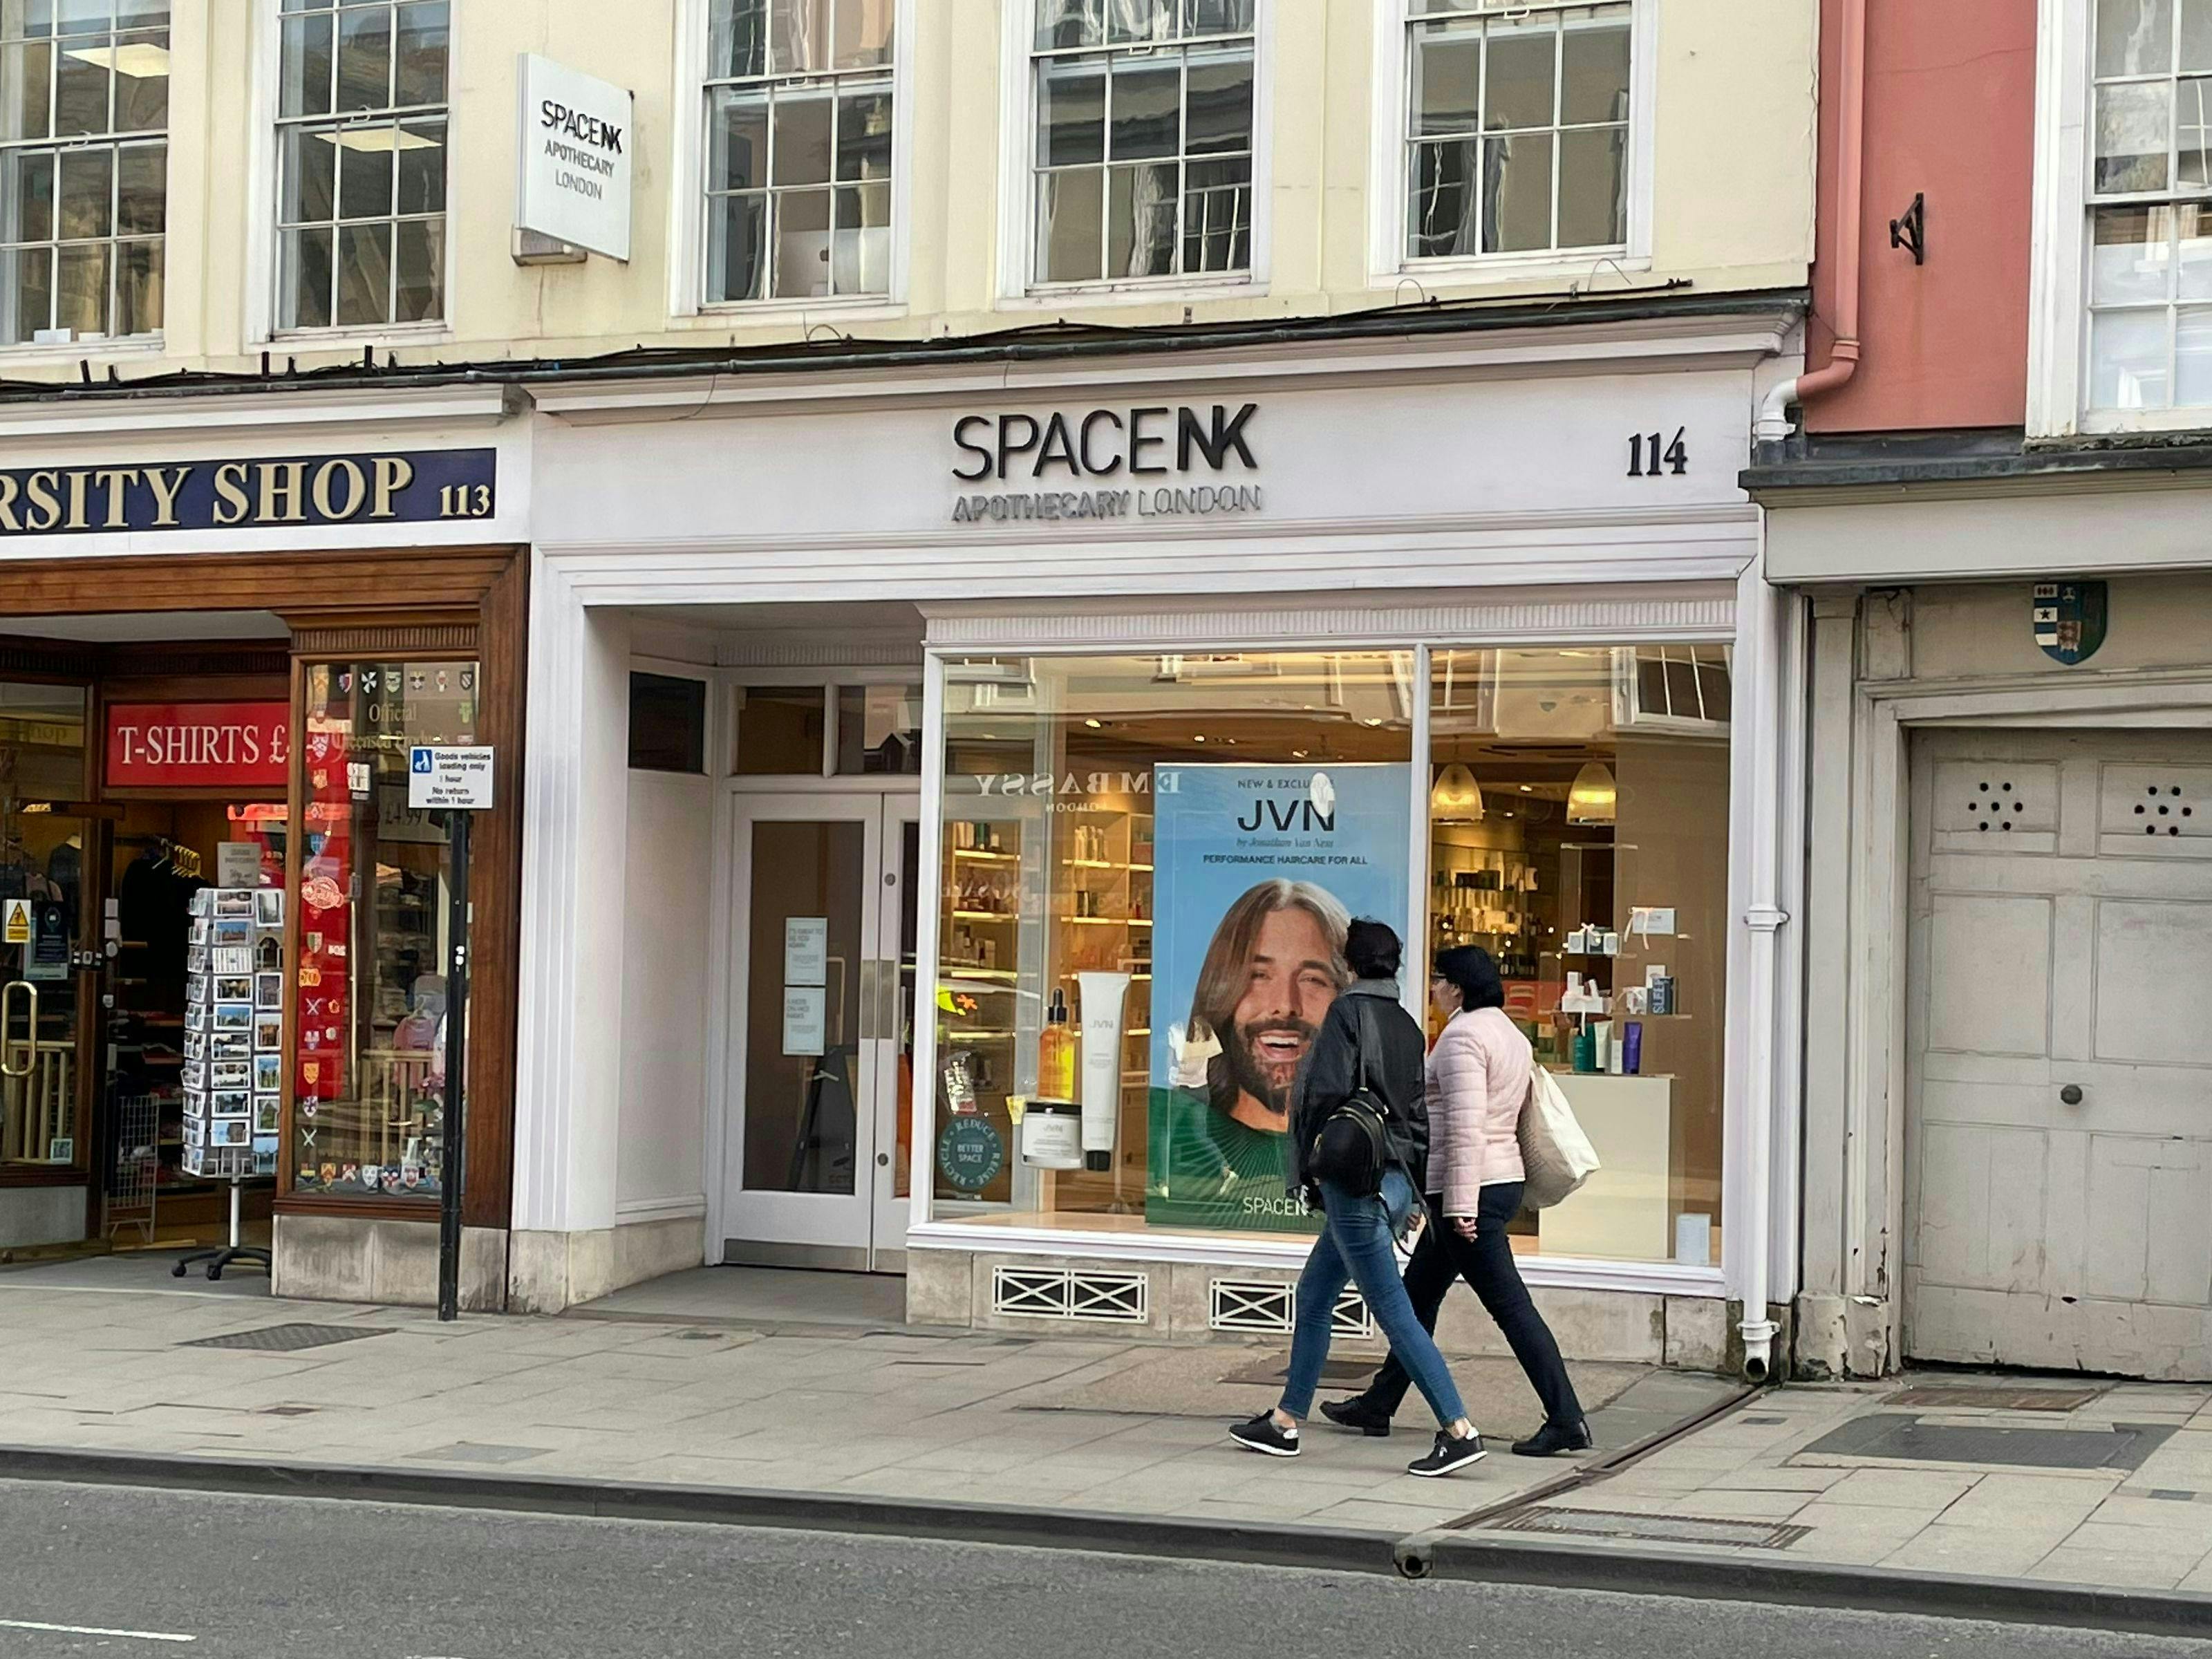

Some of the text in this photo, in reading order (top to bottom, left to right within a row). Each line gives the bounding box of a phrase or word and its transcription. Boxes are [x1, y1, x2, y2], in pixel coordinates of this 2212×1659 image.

[545, 139, 615, 178] APOTHECARY
[555, 169, 603, 200] LONDON
[1627, 426, 1687, 476] 114
[212, 457, 413, 525] SHOP
[440, 485, 491, 516] 113
[952, 485, 1260, 522] APOTHECARY LONDON
[118, 725, 259, 765] T-SHIRTS
[435, 752, 491, 760] Goods vehicles
[469, 762, 485, 771] only
[432, 787, 443, 795] No
[1238, 779, 1263, 789] NEW
[1267, 779, 1273, 789] &
[1237, 799, 1335, 832] JVN
[1203, 855, 1368, 865] PERFORMANCE HAIRCARE FOR ALL
[1089, 1020, 1114, 1029] JVN
[957, 1154, 983, 1163] SPACE
